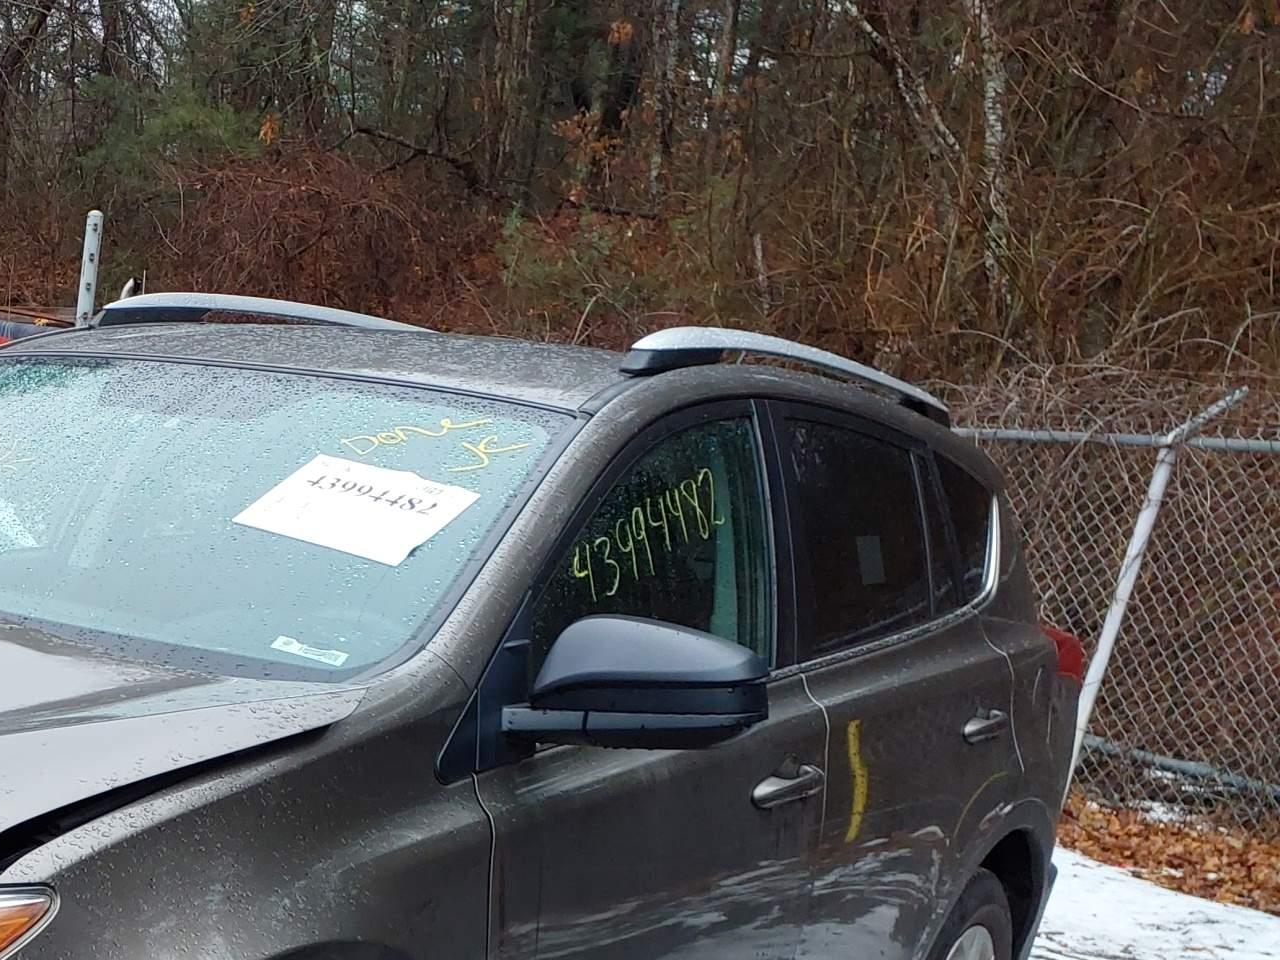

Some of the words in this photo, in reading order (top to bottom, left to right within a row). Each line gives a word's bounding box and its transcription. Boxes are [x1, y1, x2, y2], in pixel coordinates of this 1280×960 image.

[340, 418, 493, 456] Done
[306, 473, 439, 516] 43994482
[572, 467, 726, 602] 43994482
